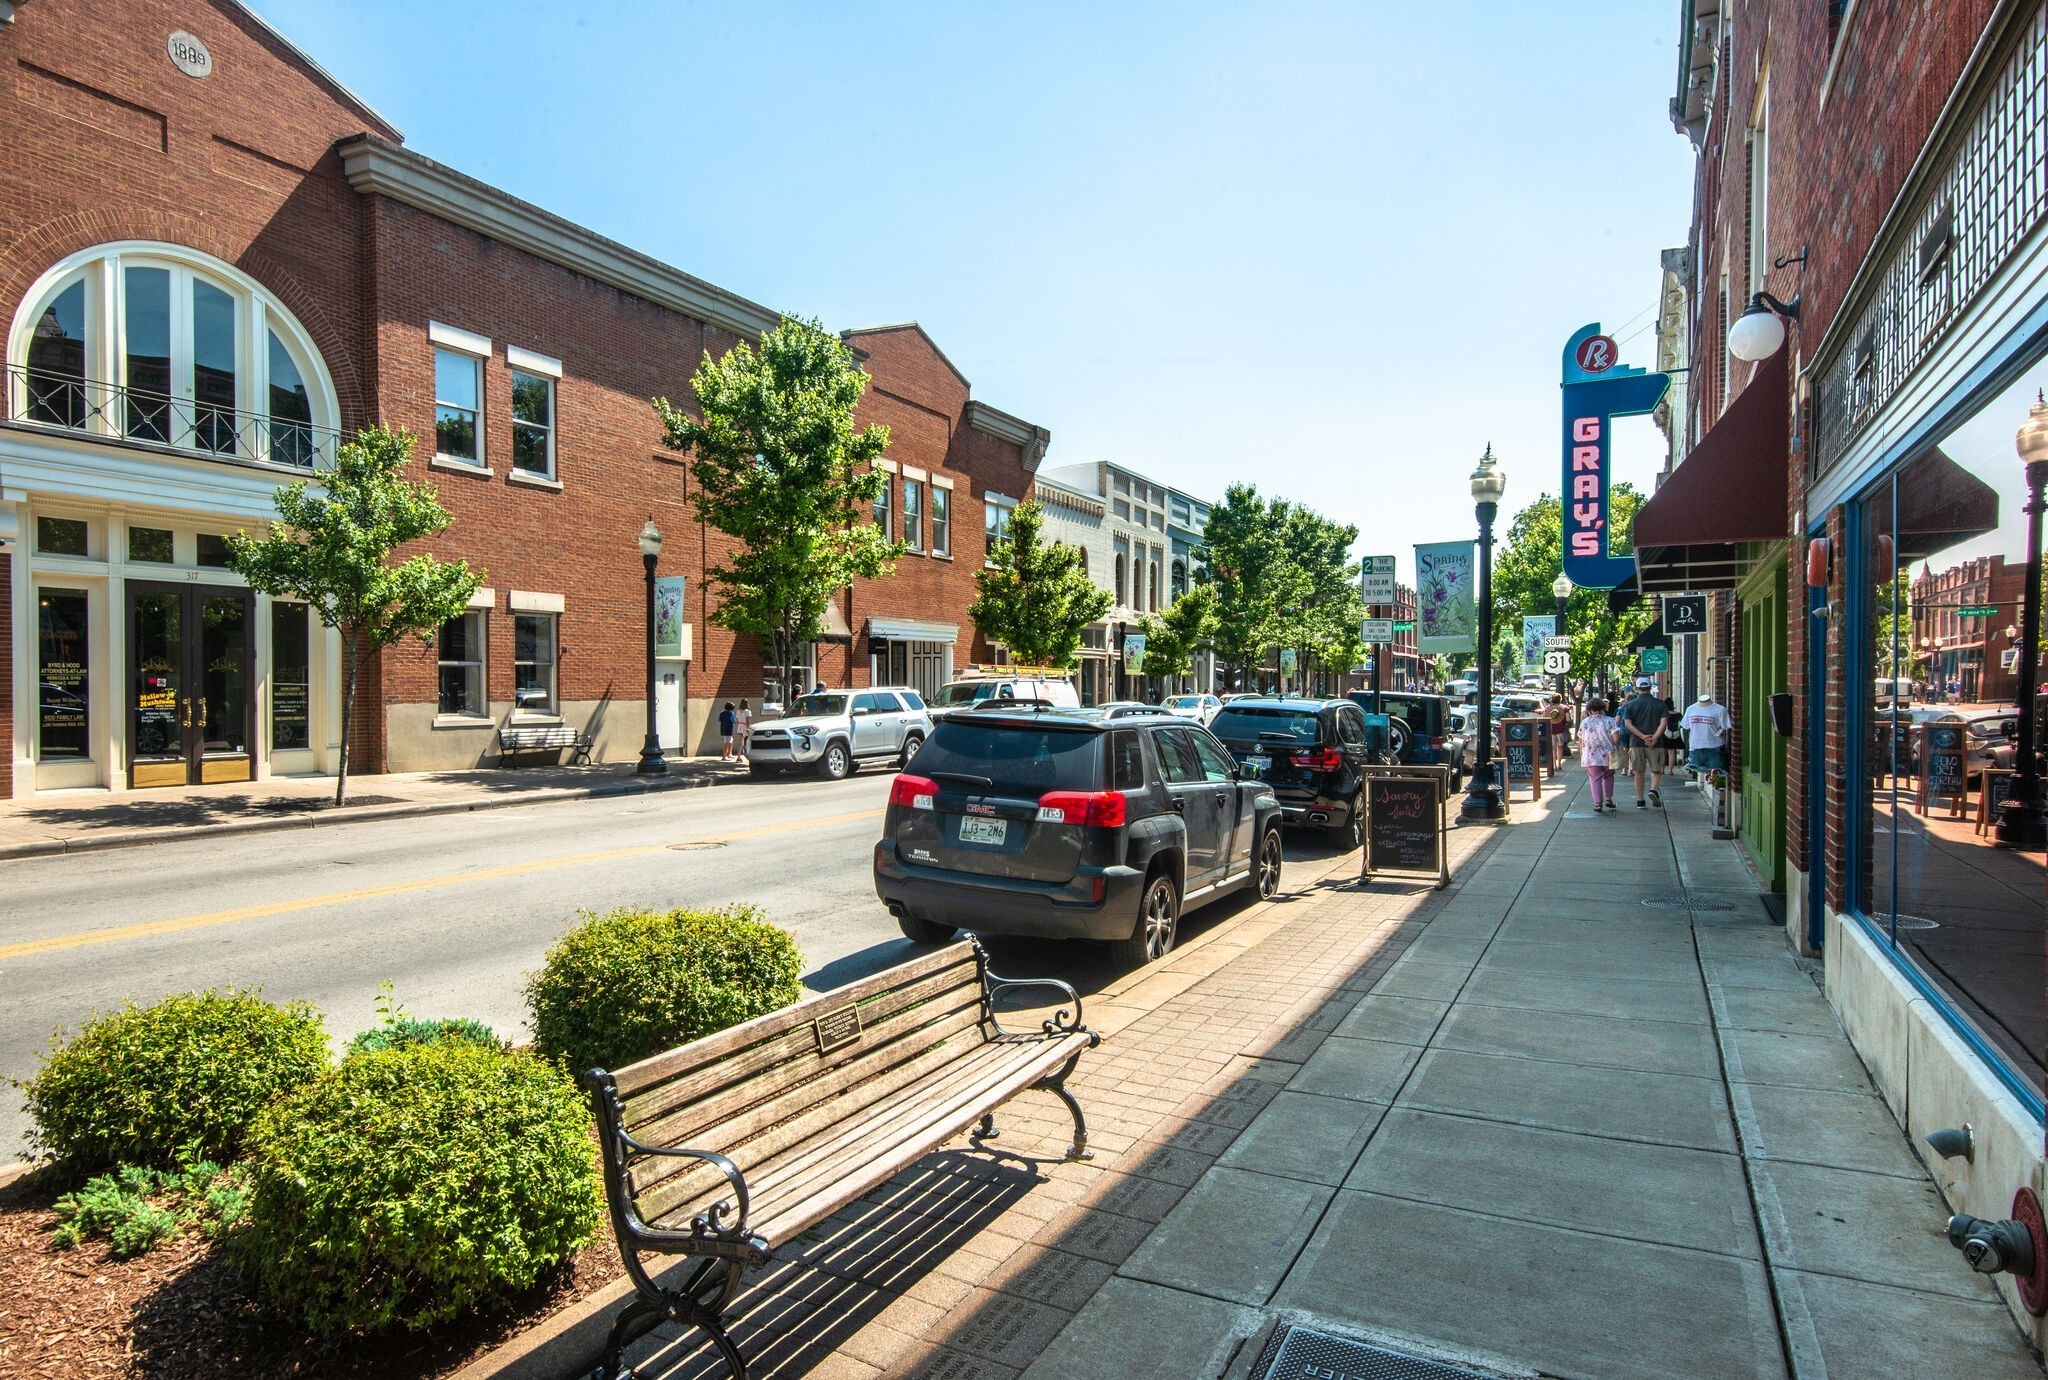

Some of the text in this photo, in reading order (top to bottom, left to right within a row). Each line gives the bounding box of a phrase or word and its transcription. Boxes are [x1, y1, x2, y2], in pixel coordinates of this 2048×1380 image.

[172, 39, 205, 65] 1889
[1572, 417, 1604, 556] GRAY'S
[1364, 560, 1372, 573] 2
[1421, 553, 1469, 573] Spring
[186, 571, 199, 580] 317
[1526, 621, 1552, 631] Spring
[1549, 656, 1565, 669] 31
[140, 692, 165, 700] Mellow
[1512, 756, 1526, 764] 150
[966, 804, 995, 814] GMC
[908, 853, 938, 862] TERRAIN
